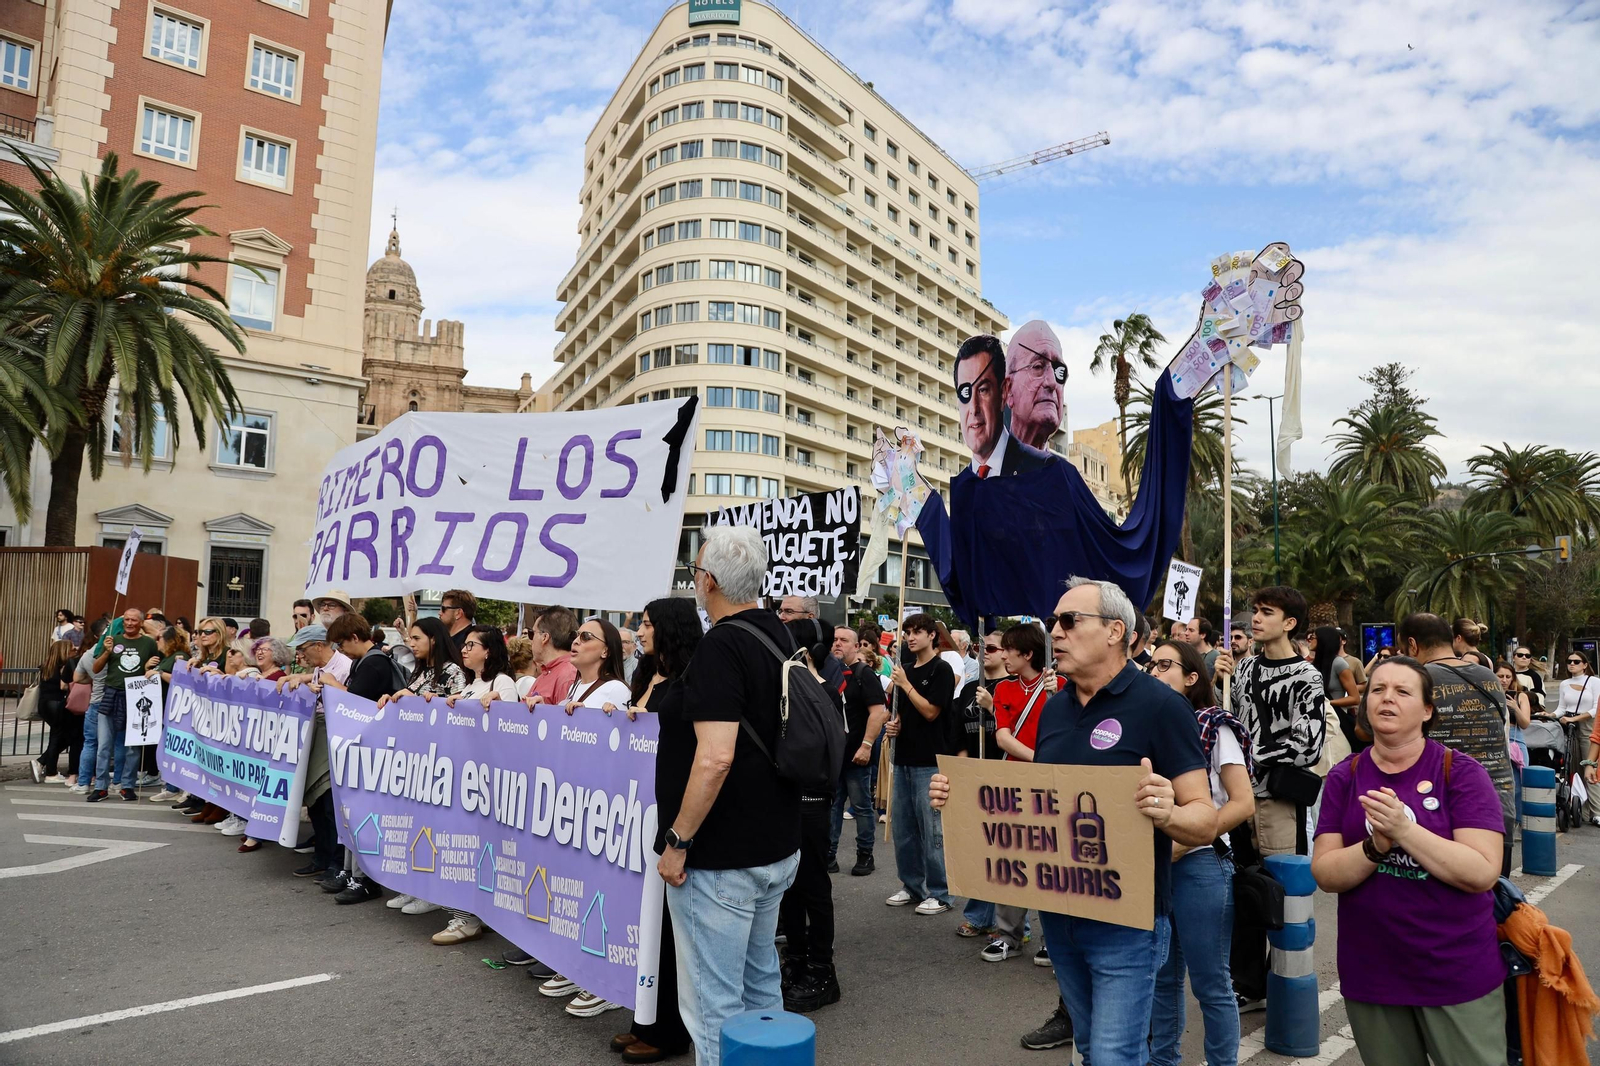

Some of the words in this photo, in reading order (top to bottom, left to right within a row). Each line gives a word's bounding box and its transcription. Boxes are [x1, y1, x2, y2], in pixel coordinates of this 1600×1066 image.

[695, 12, 734, 20] MARRIOTT
[1202, 320, 1213, 337] 100
[1185, 340, 1200, 361] 500
[1192, 352, 1210, 370] 500
[316, 434, 447, 526] RIMERO
[509, 429, 642, 501] LOS
[825, 485, 858, 525] NO
[305, 506, 587, 589] BARRIOS
[763, 560, 844, 598] DERECHO
[1432, 683, 1466, 700] EYENDAS
[168, 685, 192, 723] OP
[335, 703, 375, 724] Podemo
[398, 709, 424, 723] Podemos
[446, 712, 476, 728] Podemos
[498, 718, 529, 736] Podemos
[561, 725, 598, 745] Podemos
[232, 758, 246, 780] NO
[329, 734, 455, 807] Vivienda
[461, 760, 490, 817] es
[493, 767, 528, 831] un
[979, 785, 1023, 815] QUE
[1031, 788, 1060, 815] TE
[436, 830, 450, 849] MÁS
[451, 833, 480, 849] VIVIENDA
[982, 822, 1059, 853] VOTEN
[441, 848, 468, 865] PÚBLICA
[470, 852, 475, 866] Y
[440, 866, 476, 884] ASEQUIBLE
[986, 857, 1028, 888] LOS
[1036, 865, 1122, 900] GUIRIS
[550, 876, 584, 899] MORATORIA
[554, 896, 562, 914] DE
[562, 899, 579, 918] PISOS
[550, 915, 580, 941] TURÍSTICOS
[626, 924, 640, 944] ST
[608, 944, 640, 967] ESPEC
